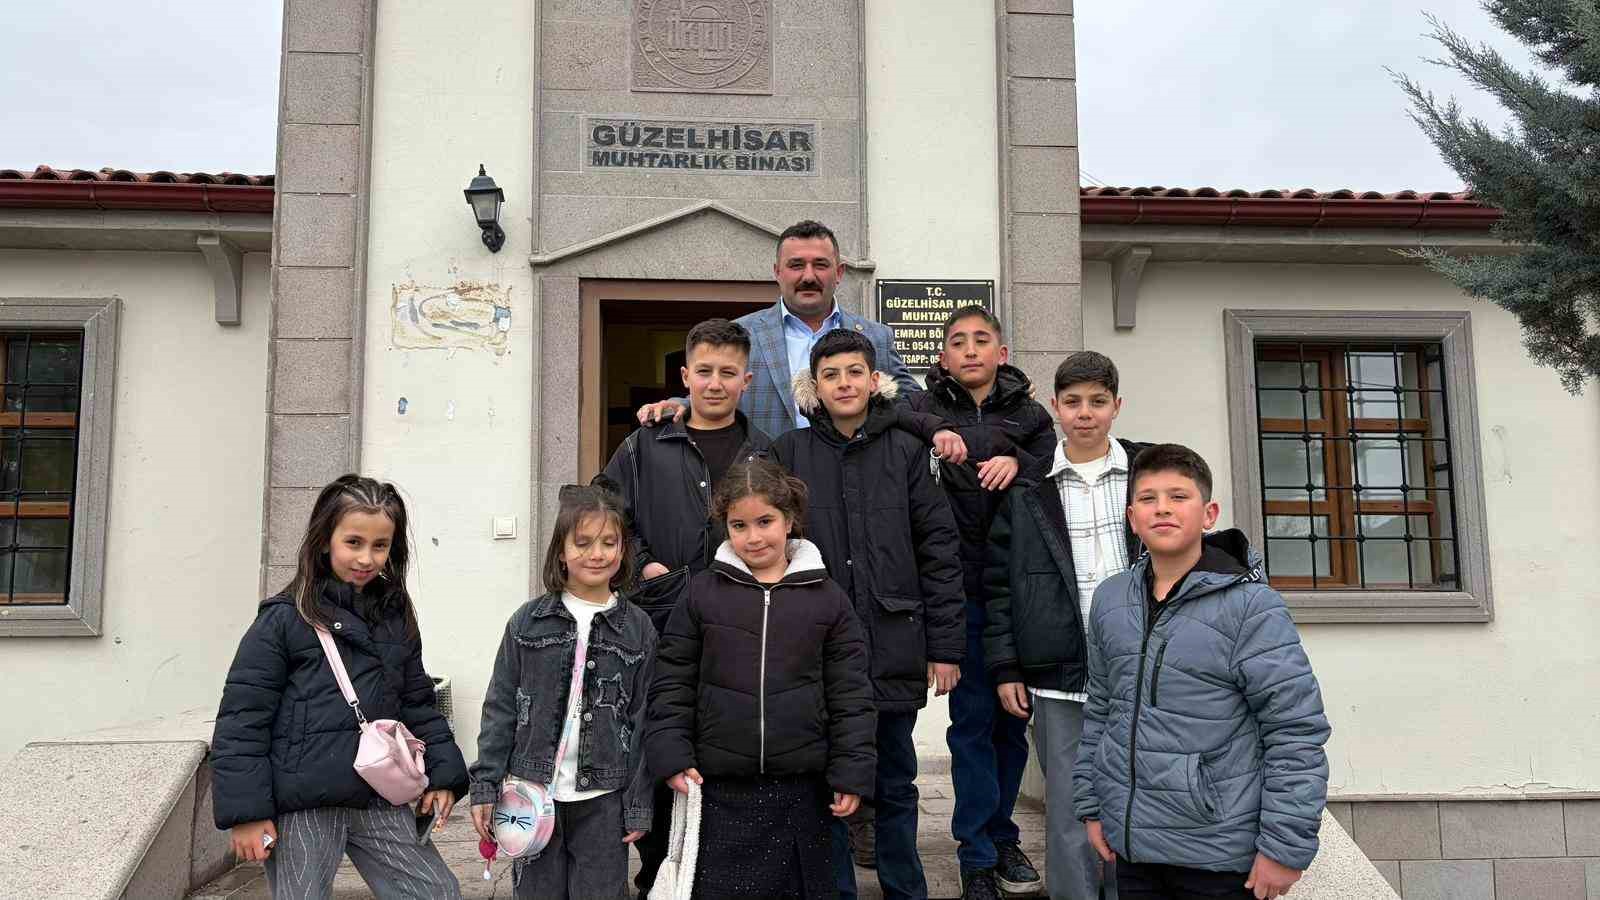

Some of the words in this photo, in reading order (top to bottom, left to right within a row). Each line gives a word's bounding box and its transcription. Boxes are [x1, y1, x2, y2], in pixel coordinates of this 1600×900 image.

[592, 122, 812, 151] GÜZELHİSAR
[592, 151, 730, 169] MUHTARLIK
[735, 152, 811, 171] BİNASI
[925, 287, 946, 297] T.C.
[886, 297, 954, 309] GÜZELHİSAR
[902, 311, 952, 321] MUHTAR
[894, 329, 926, 339] EMRAH
[912, 341, 935, 350] 0543
